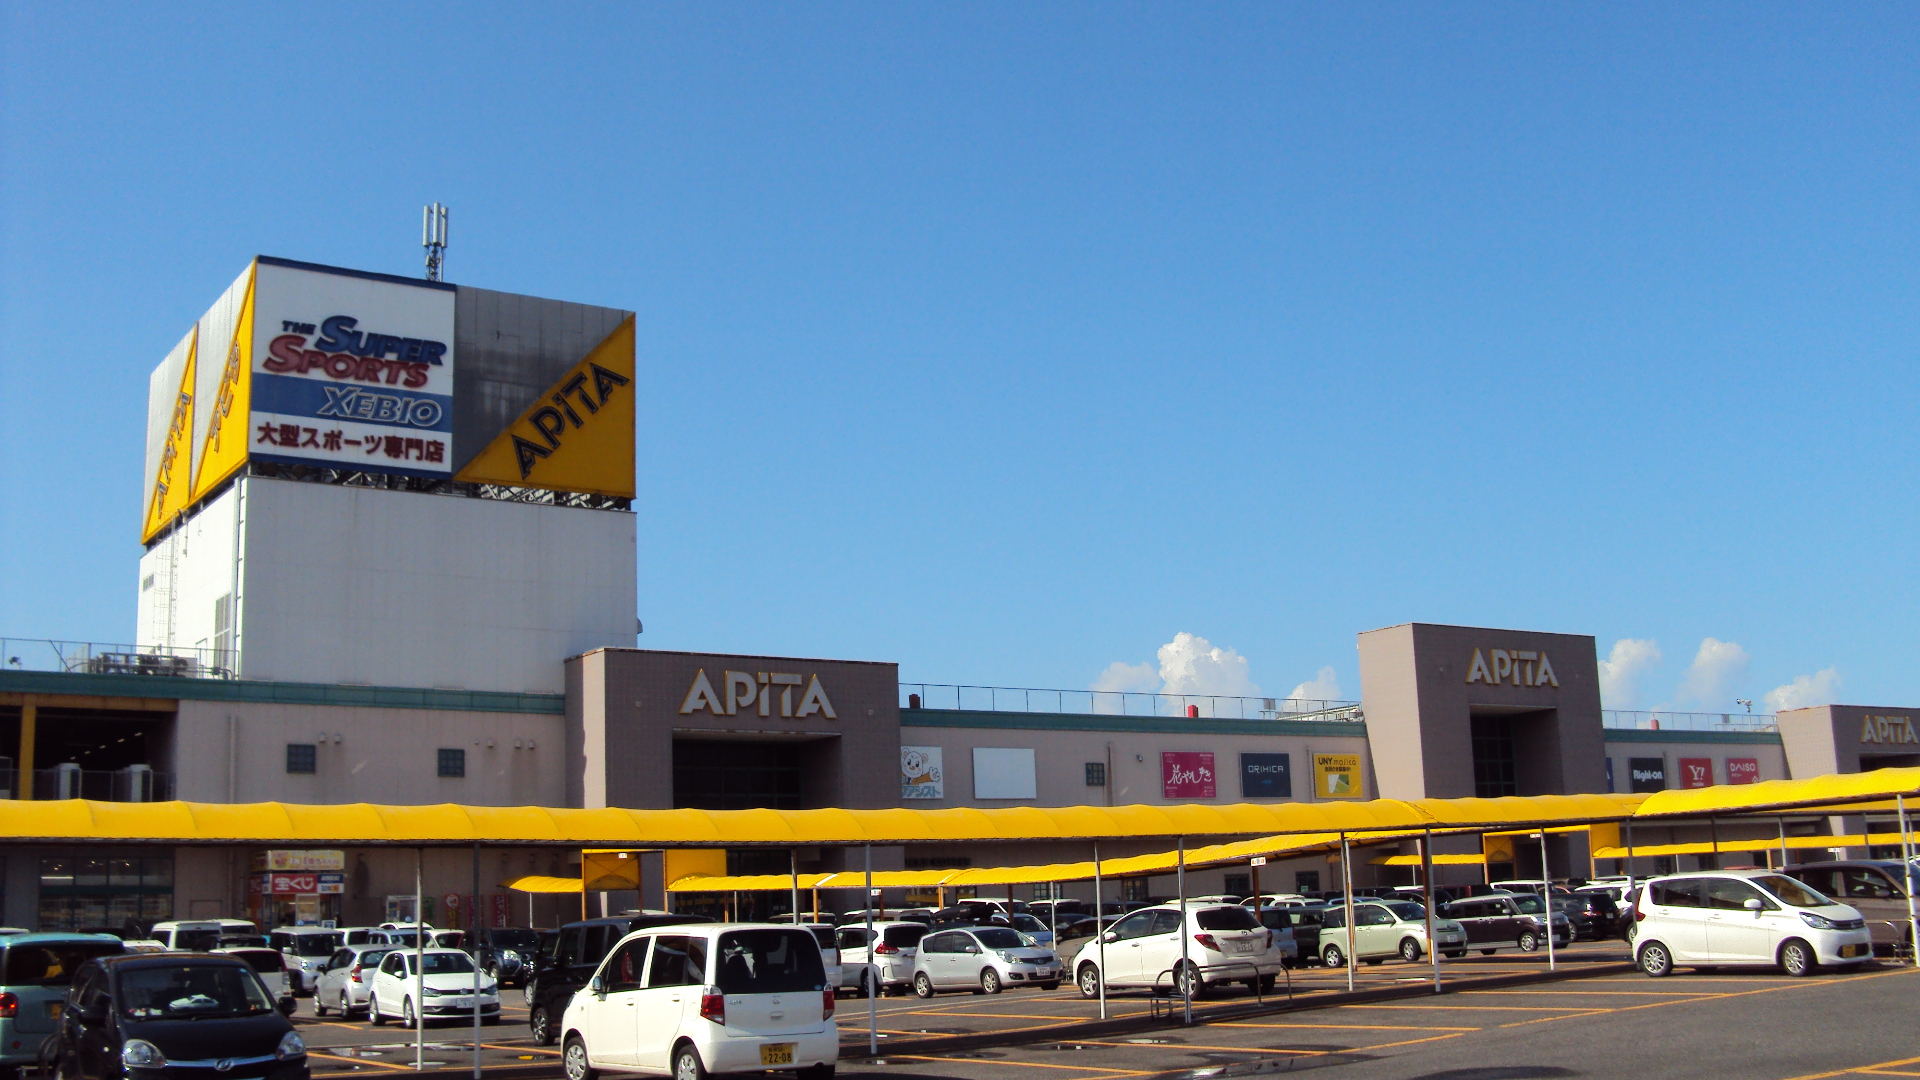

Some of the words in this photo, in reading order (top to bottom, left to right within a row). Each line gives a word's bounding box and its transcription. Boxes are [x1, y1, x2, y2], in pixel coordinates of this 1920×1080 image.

[282, 320, 317, 335] THE
[314, 315, 447, 366] SUPER
[262, 334, 429, 389] SPORTS
[316, 386, 442, 427] XEBIO
[257, 422, 445, 463] 大型スポーツ専門店
[1318, 757, 1332, 766] UNY
[1730, 763, 1756, 772] DAISO
[1247, 765, 1284, 774] ORIHICA
[1633, 769, 1663, 782] Right-on
[274, 877, 314, 891] 宝くじ
[768, 1053, 792, 1064] 22-08
